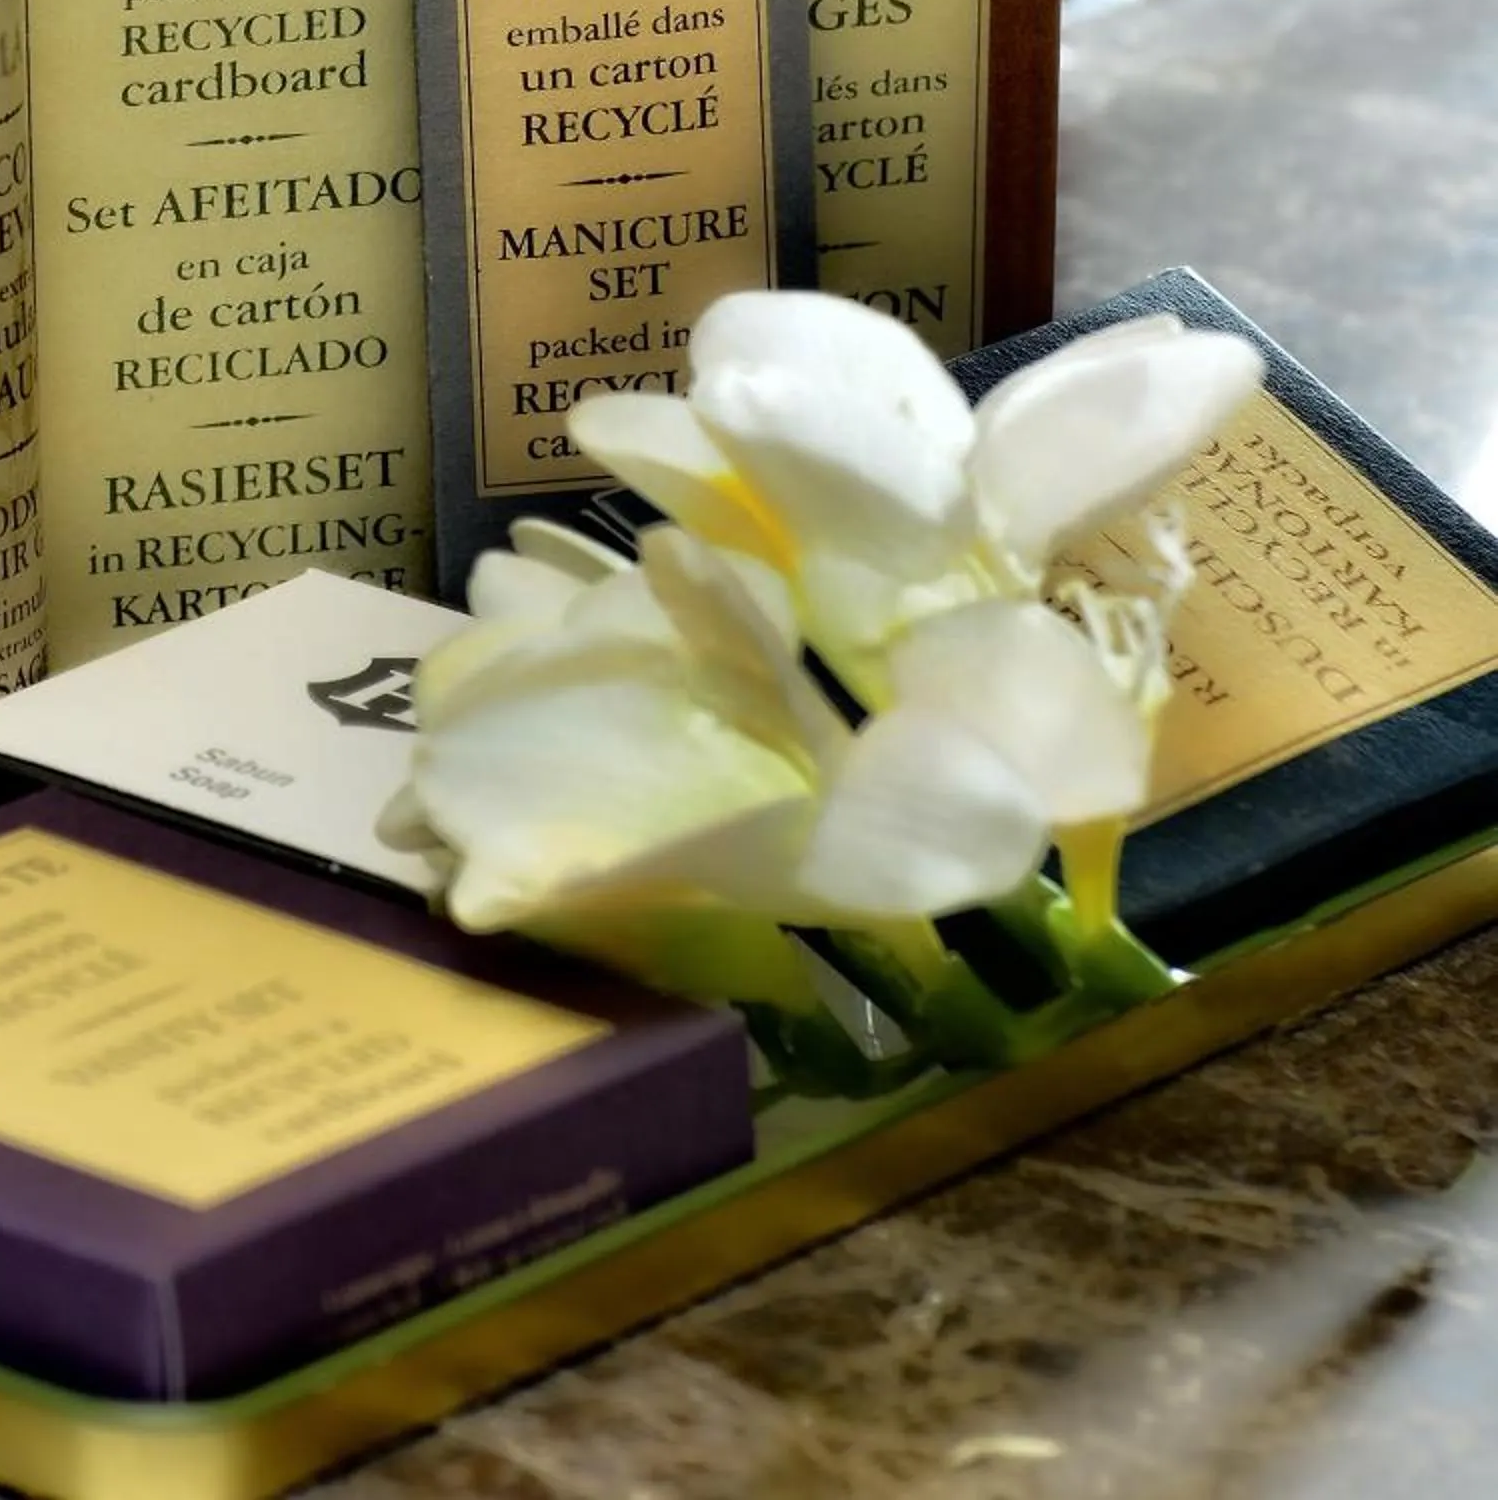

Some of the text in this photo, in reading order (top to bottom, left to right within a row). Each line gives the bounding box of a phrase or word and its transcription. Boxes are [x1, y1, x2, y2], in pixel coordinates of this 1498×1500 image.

[120, 5, 366, 57] RECYCLED
[507, 5, 725, 47] emballé dans
[121, 51, 368, 107] cardboard
[520, 50, 718, 92] un carton
[871, 69, 948, 99] dans
[521, 85, 720, 146] RECYCLÉ
[816, 113, 925, 143] arton
[817, 144, 928, 193] YCLÉ
[67, 167, 422, 234] Set AFEITADO
[498, 203, 748, 260] MANICURE
[177, 241, 309, 281] en caja
[589, 263, 670, 302] SET
[137, 282, 361, 335] de cartón
[114, 335, 388, 392] RECICLADO
[529, 323, 649, 368] packed
[105, 448, 404, 515] RASIERSET
[88, 512, 424, 575] in RECYCLING-
